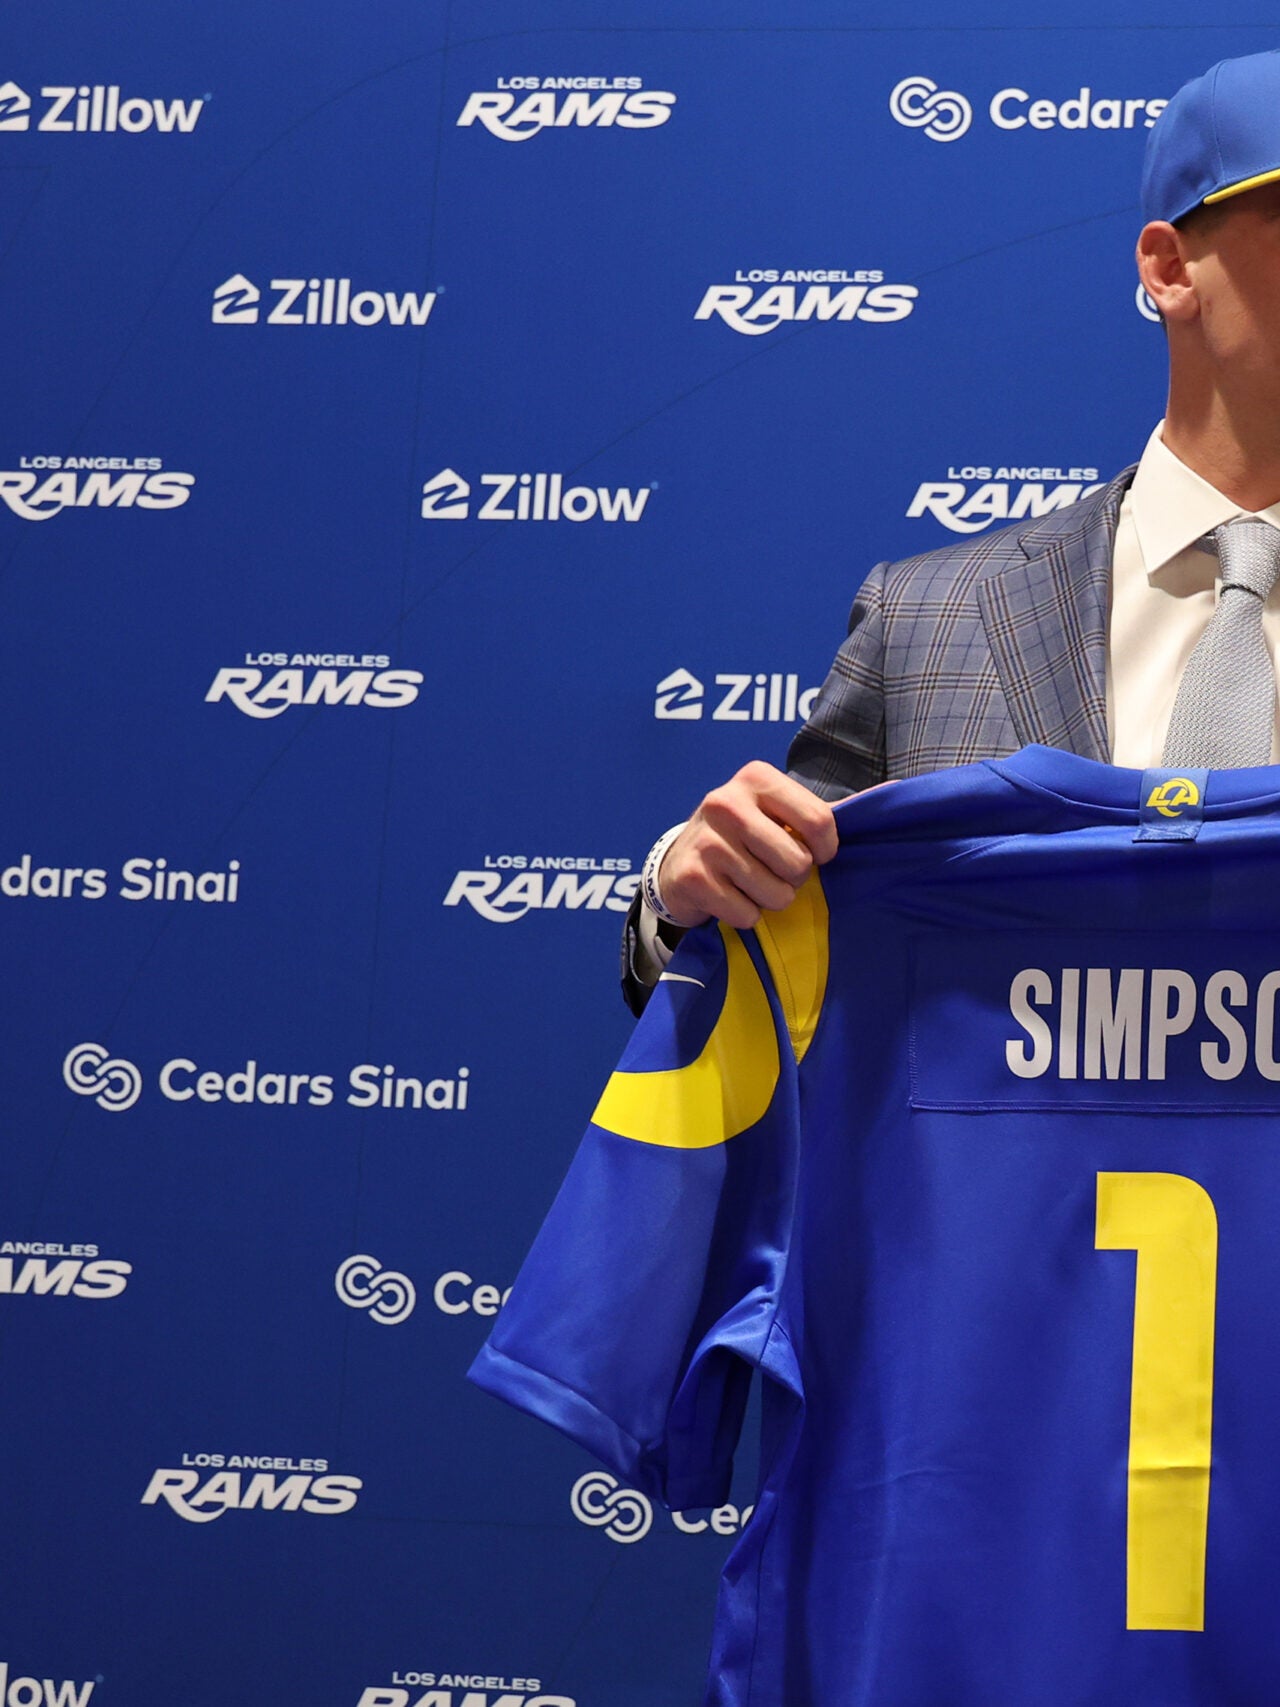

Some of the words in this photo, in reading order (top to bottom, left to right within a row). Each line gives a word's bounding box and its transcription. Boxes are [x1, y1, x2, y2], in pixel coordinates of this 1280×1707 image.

[497, 77, 539, 88] LOS
[542, 77, 642, 89] ANGELES
[38, 86, 203, 132] Zillow
[457, 91, 676, 141] RAMS
[989, 87, 1169, 129] Cedars
[736, 270, 779, 282] LOS
[781, 270, 883, 283] ANGELES
[268, 279, 436, 325] Zillow
[694, 285, 918, 335] RAMS
[21, 457, 61, 468] LOS
[64, 457, 161, 470] ANGELES
[948, 467, 992, 479] LOS
[994, 468, 1098, 480] ANGELES
[0, 472, 195, 520] RAMS
[478, 474, 650, 521] Zillow
[905, 483, 1108, 533] RAM
[246, 653, 287, 665] LOS
[291, 654, 389, 667] ANGELES
[205, 668, 423, 718] RAMS
[1, 855, 106, 898] dars
[120, 858, 239, 902] Sinai
[485, 856, 527, 868] LOS
[530, 857, 631, 871] ANGELES
[160, 1059, 333, 1105] Cedars
[348, 1065, 469, 1109] Sinai
[0, 1242, 98, 1257] ANGELES
[0, 1258, 132, 1298] MS
[1096, 1172, 1218, 1631] 1
[183, 1454, 224, 1467] LOS
[228, 1456, 327, 1471] ANGELES
[141, 1469, 362, 1522] RAMS
[393, 1672, 435, 1685] LOS
[438, 1675, 540, 1691] ANGELES
